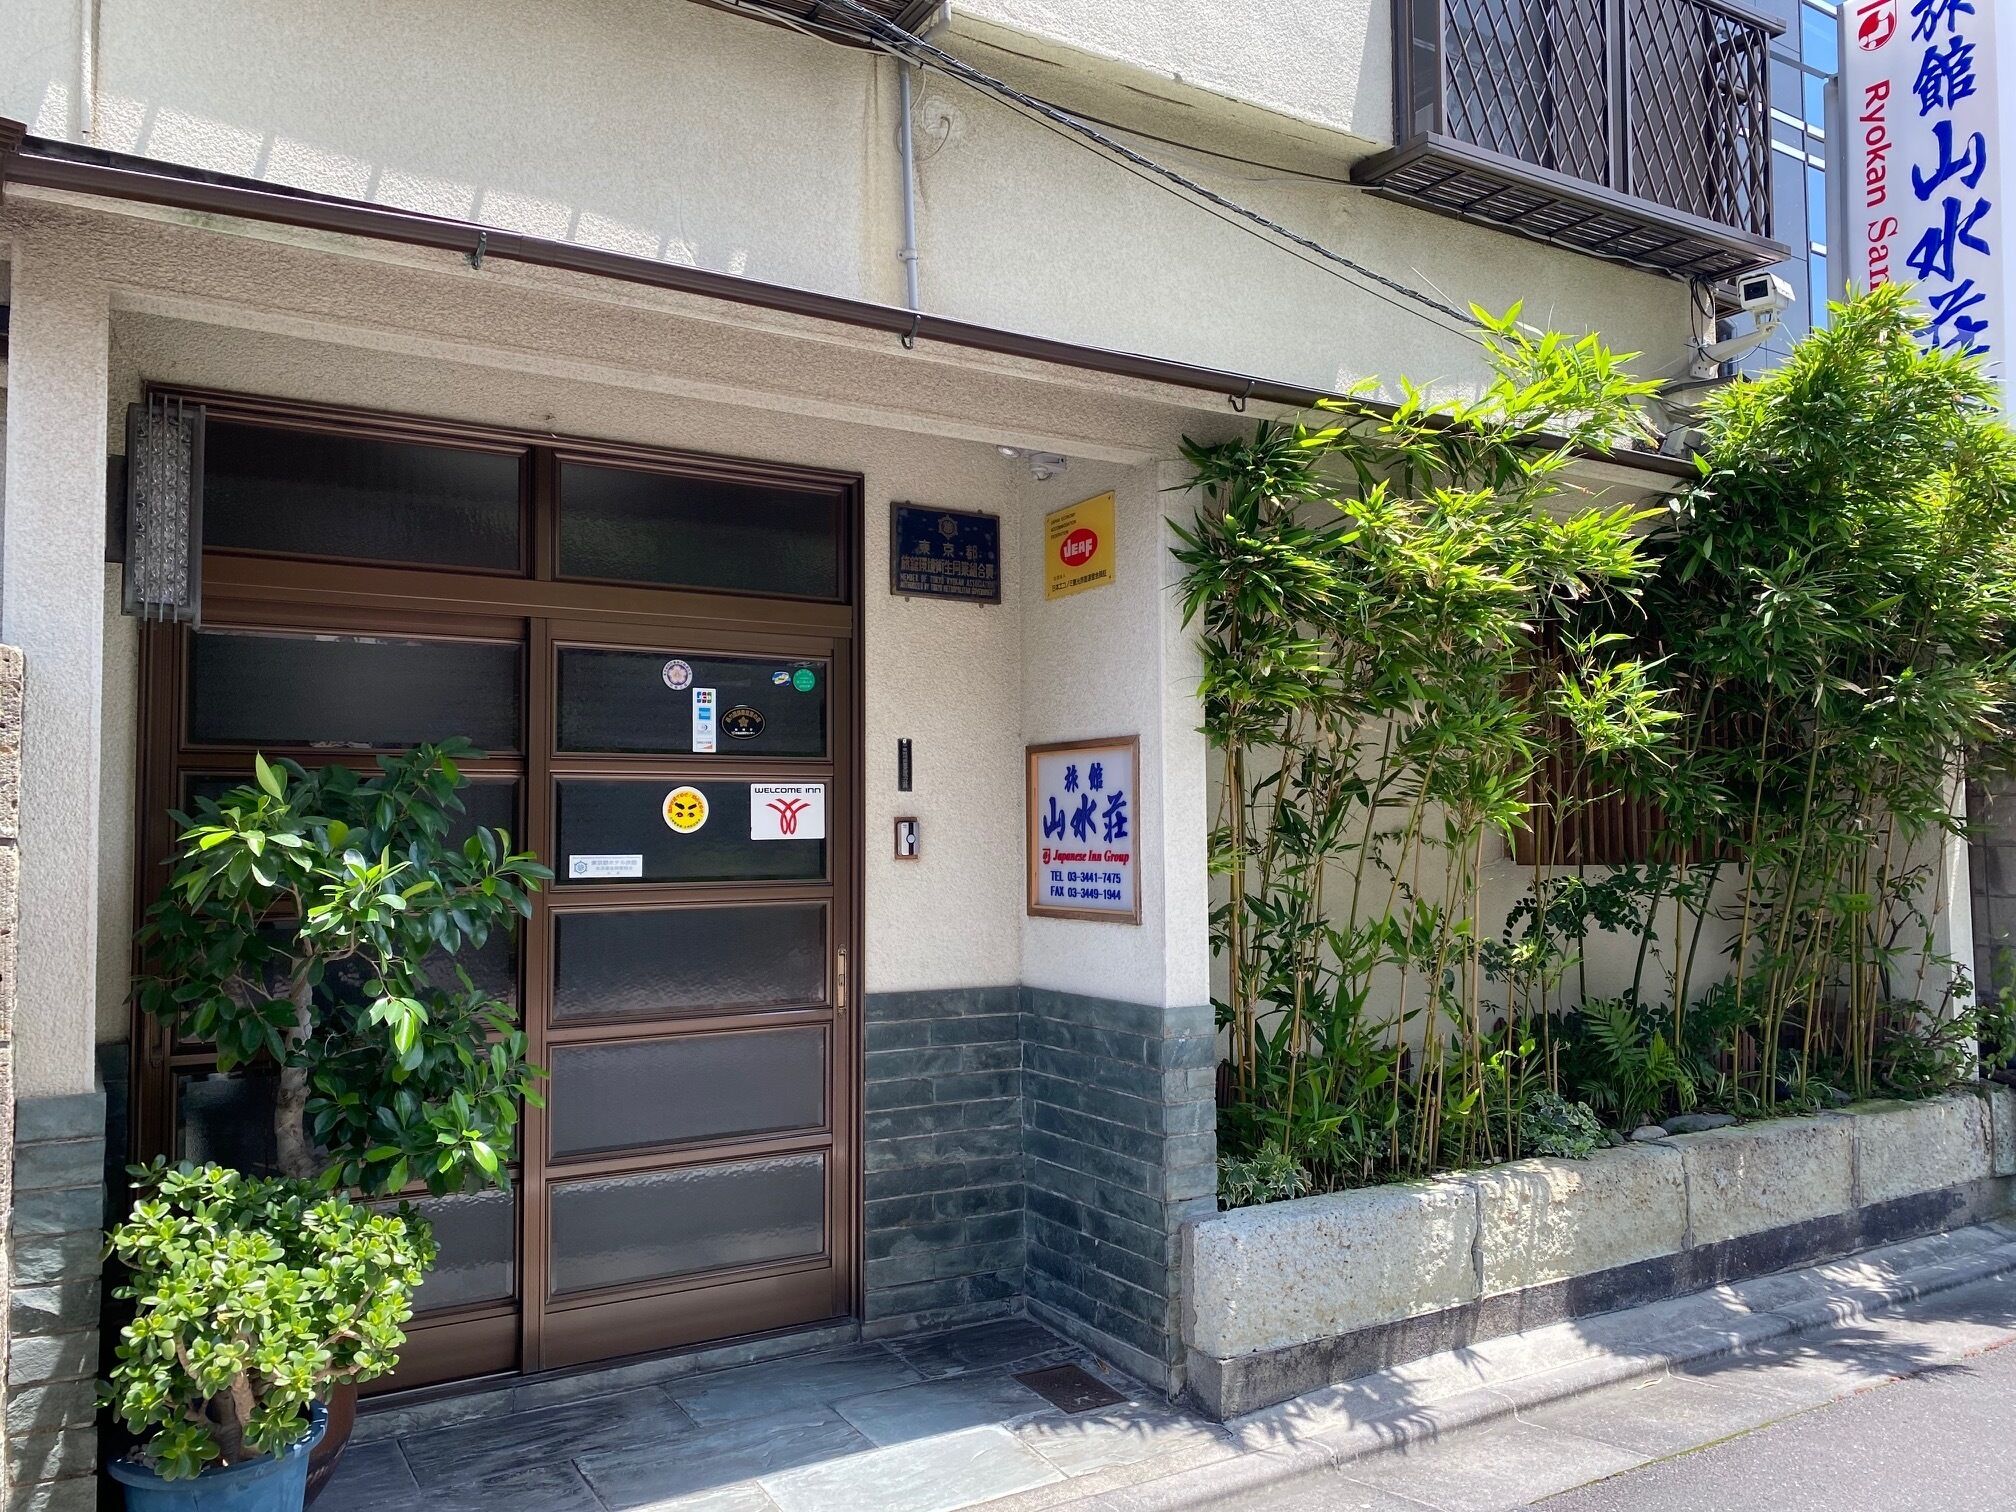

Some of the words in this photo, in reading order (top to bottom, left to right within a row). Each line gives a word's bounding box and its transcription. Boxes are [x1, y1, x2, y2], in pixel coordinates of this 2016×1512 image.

[1859, 79, 1892, 208] Ryokan
[918, 539, 978, 560] 東京都
[1064, 762, 1104, 793] 旅館
[1043, 790, 1129, 843] 山水荘
[1053, 849, 1087, 865] Japanese
[1088, 849, 1102, 862] Inn
[1104, 849, 1130, 866] Group
[1050, 870, 1064, 882] TEL
[1067, 871, 1121, 884] 03-3441-7475
[1050, 885, 1065, 897] FAX
[1067, 887, 1121, 901] 03-3449-1944
